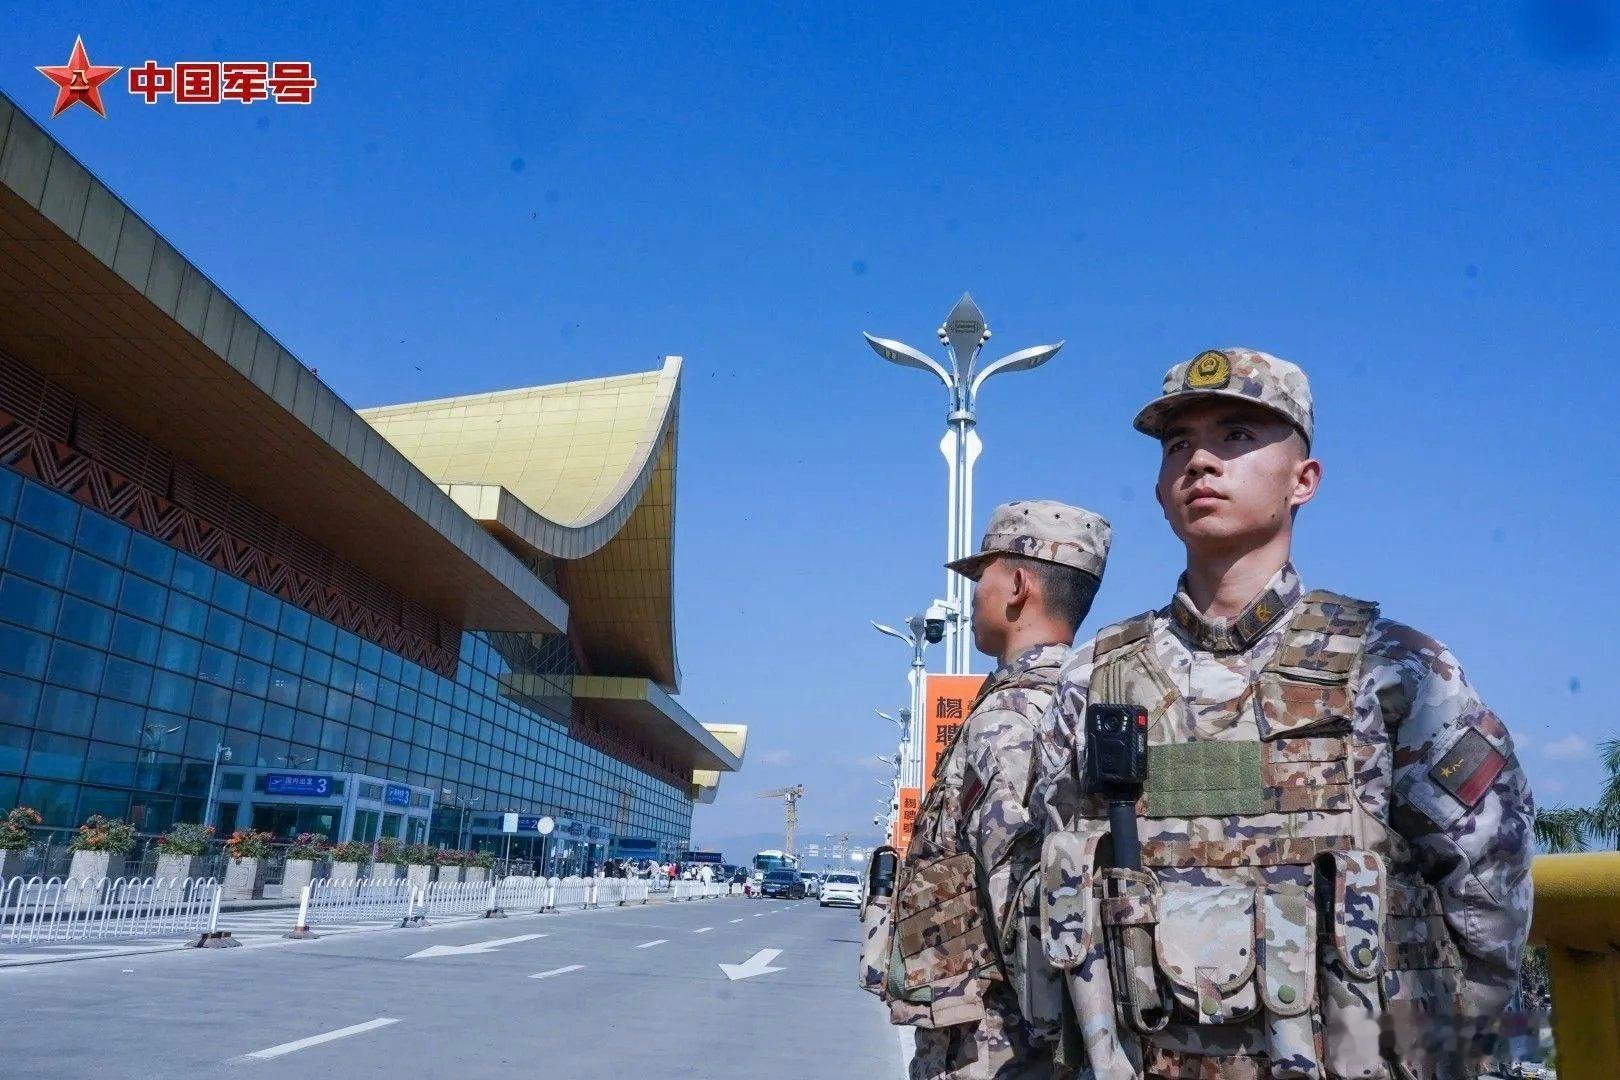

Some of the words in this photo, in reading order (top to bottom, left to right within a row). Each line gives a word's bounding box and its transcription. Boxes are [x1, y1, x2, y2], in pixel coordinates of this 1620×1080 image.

[316, 778, 328, 793] 3
[404, 790, 410, 804] 3
[531, 820, 538, 829] 2
